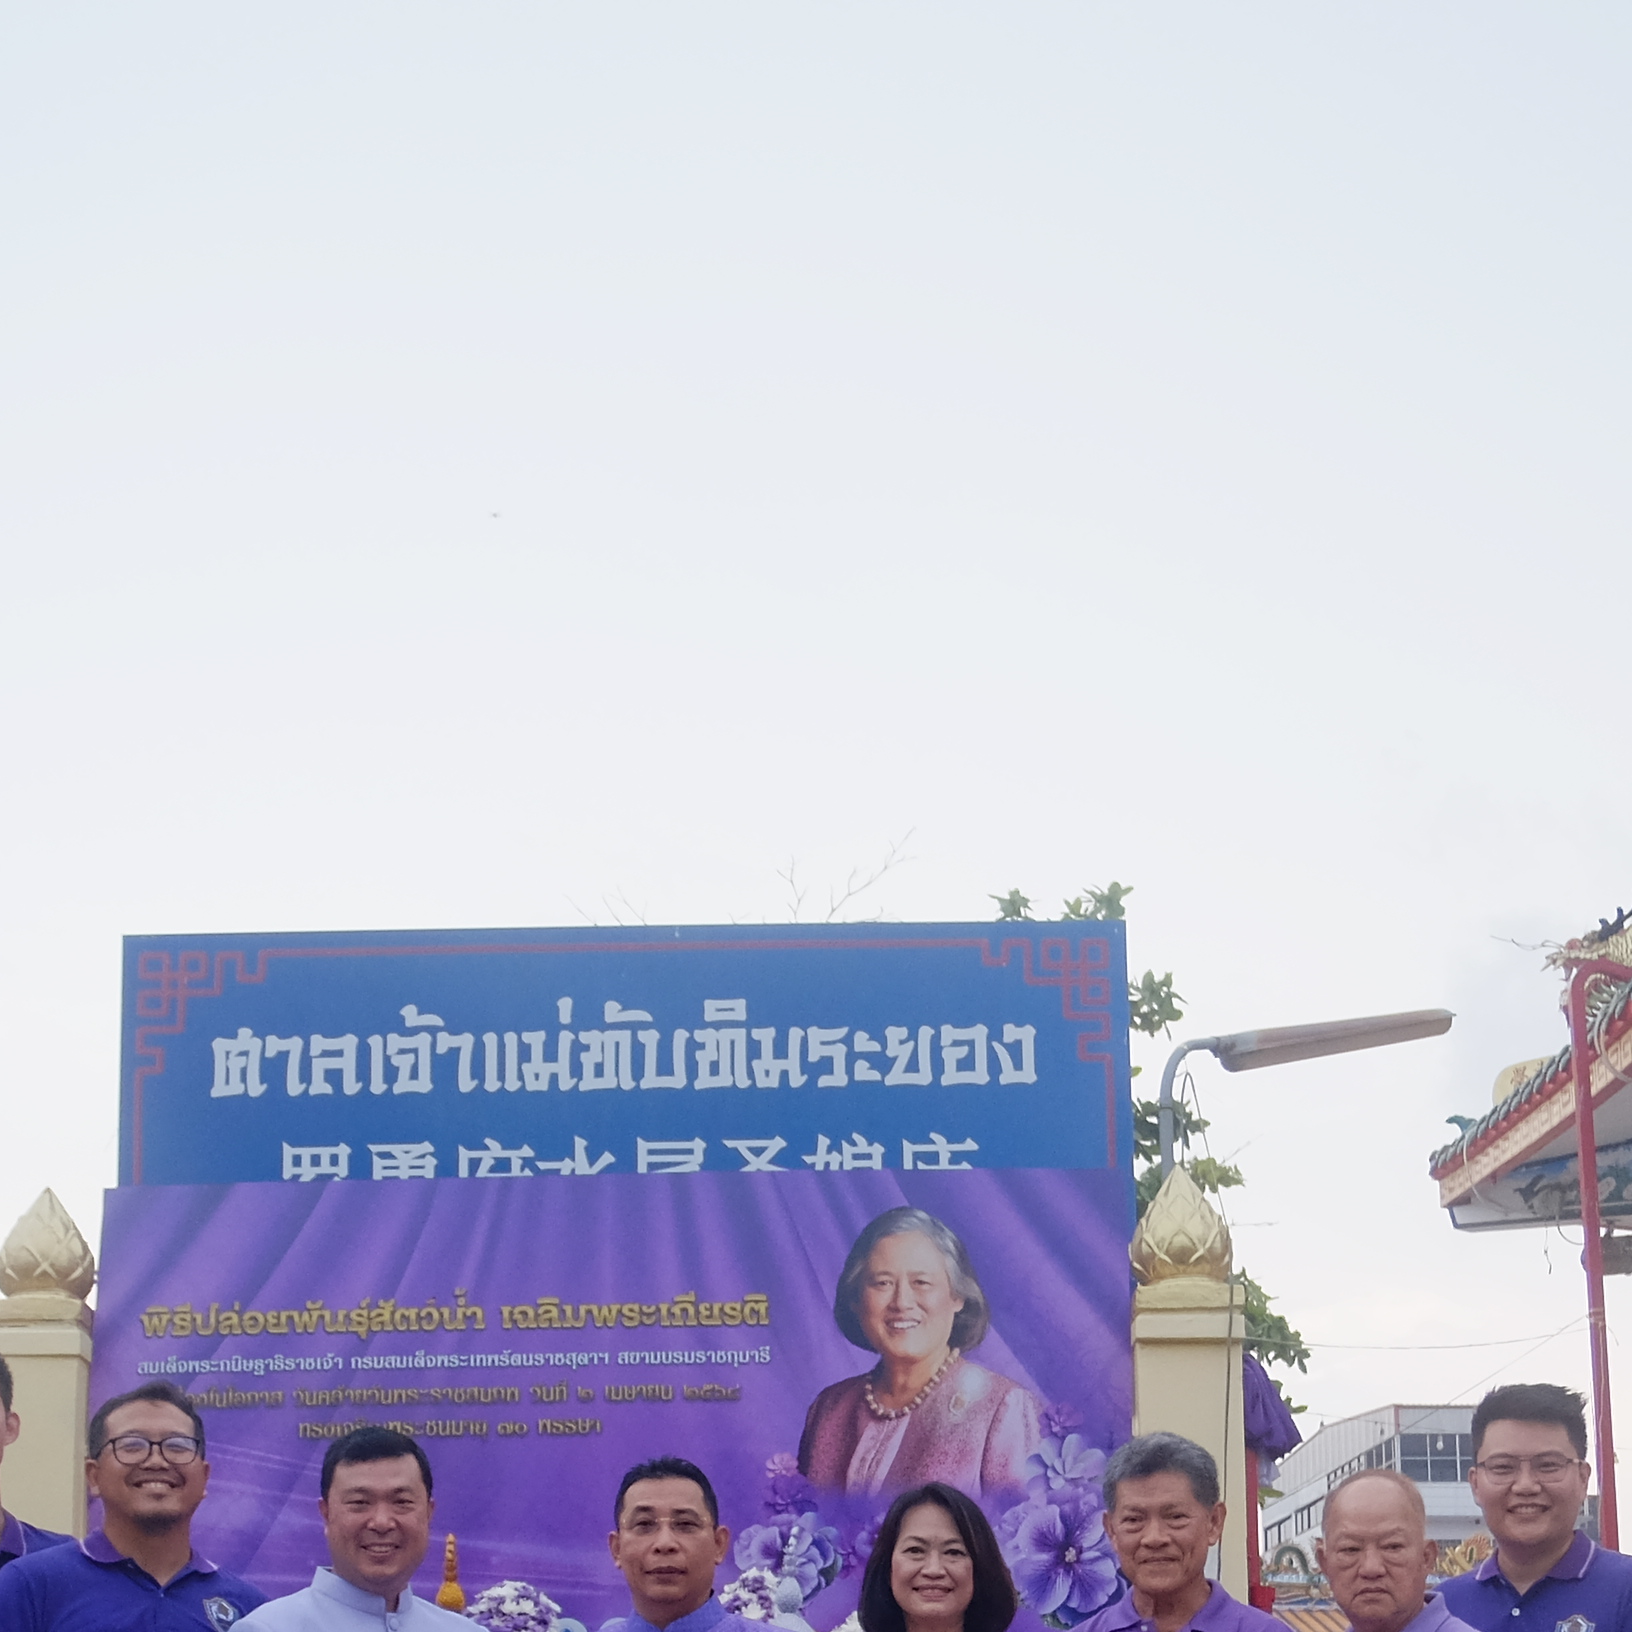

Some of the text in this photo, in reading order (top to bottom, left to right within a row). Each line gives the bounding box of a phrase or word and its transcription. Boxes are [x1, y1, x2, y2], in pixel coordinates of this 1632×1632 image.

[210, 997, 1038, 1098] ศาลเจ้าแม่ทับทิมระยอง
[140, 1287, 769, 1339] พิธีปล่อยพันธุ์สัตว์น้ำ เฉลิมพระเกียรติ
[137, 1345, 772, 1375] สมเด็จพระกนิษฐาธิราชเจ้า กรมสมเด็จพระเทพรัตนราชสุดาฯ สยามบรมราชกุมารี
[529, 1379, 567, 1402] วันที่
[604, 1383, 673, 1401] เมษายน
[537, 1417, 602, 1435] พรรษา
